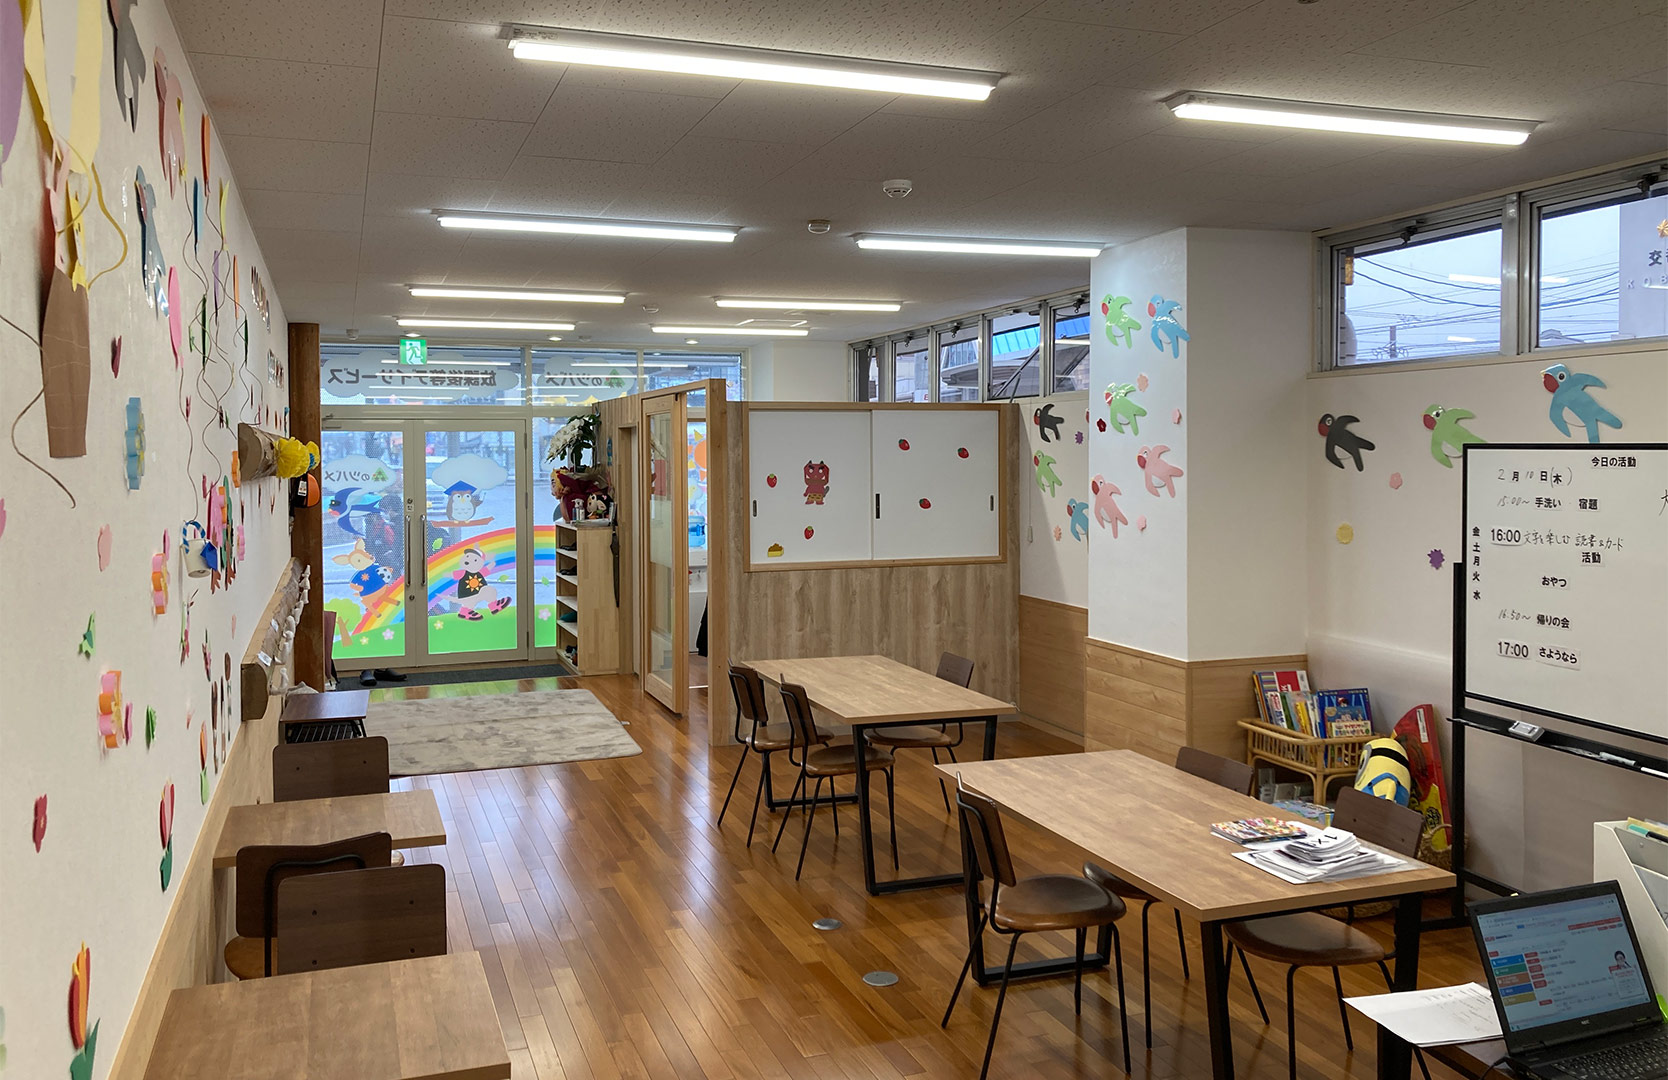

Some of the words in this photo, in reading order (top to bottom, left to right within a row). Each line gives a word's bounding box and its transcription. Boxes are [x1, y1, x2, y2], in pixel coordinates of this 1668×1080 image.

[1591, 456, 1637, 468] 今日の活動
[1534, 497, 1562, 509] 手洗い
[1578, 498, 1599, 510] 宿題
[1490, 528, 1521, 543] 16:00
[1581, 552, 1601, 564] 活動
[1541, 575, 1567, 588] おやつ
[1536, 614, 1570, 629] 帰りの会
[1498, 641, 1529, 658] 17:00
[1539, 647, 1578, 664] さようなら
